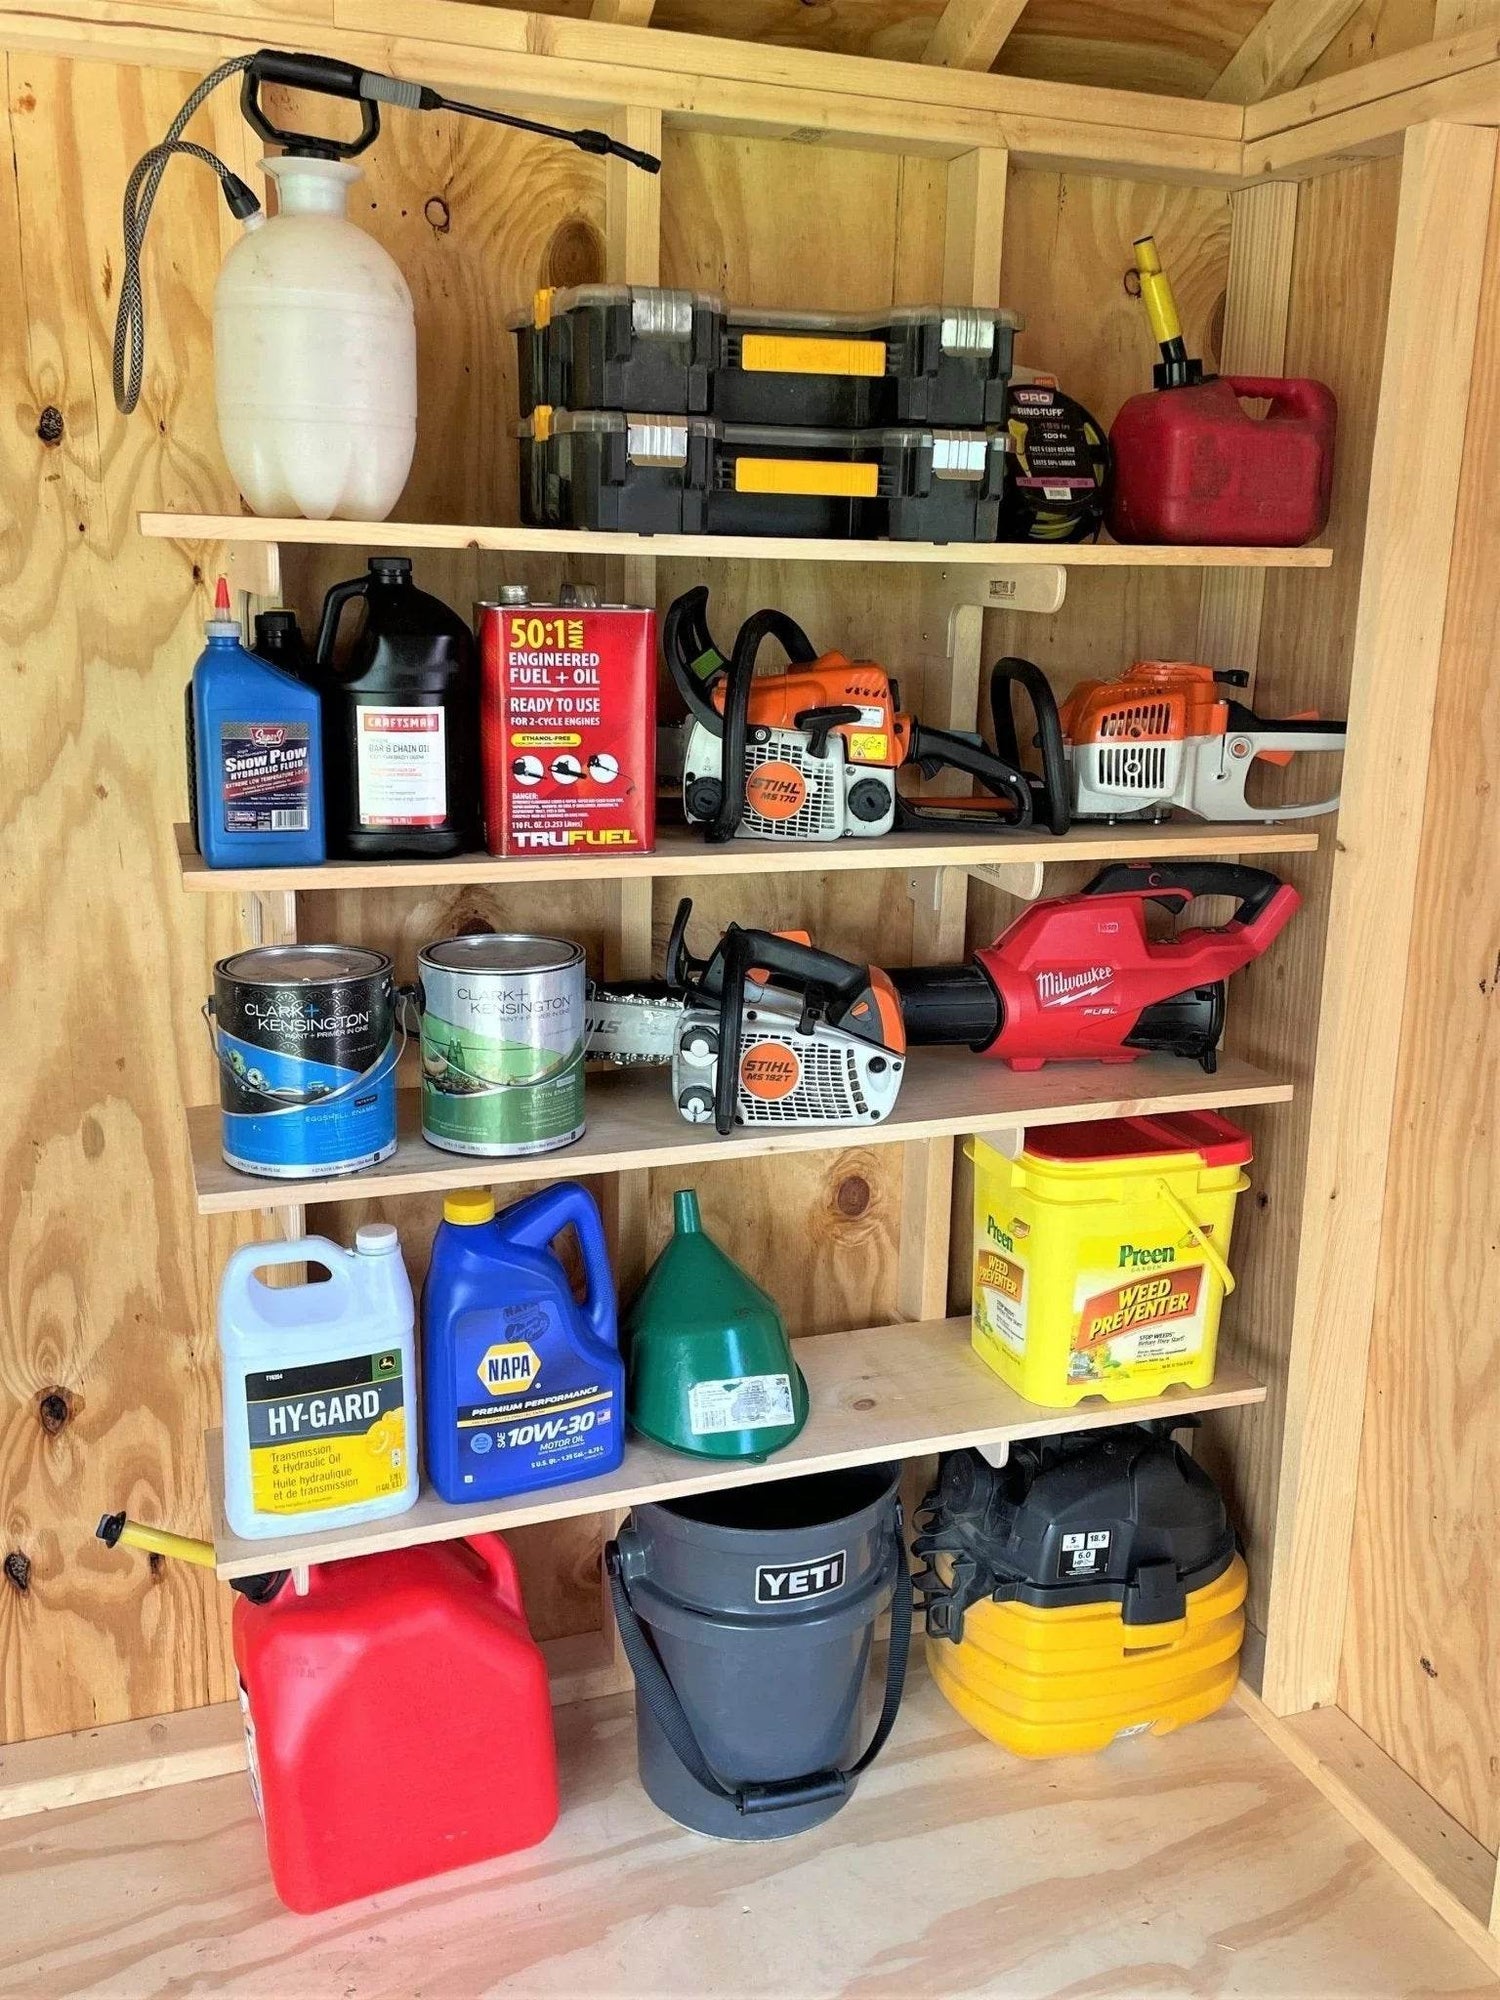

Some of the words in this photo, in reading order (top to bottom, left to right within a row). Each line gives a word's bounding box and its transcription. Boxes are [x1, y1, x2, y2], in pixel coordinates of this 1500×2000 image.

[1020, 393, 1050, 402] PRO
[510, 618, 565, 649] 50:1
[567, 620, 584, 649] MIX
[508, 652, 600, 666] ENGINEERED
[509, 667, 551, 684] FUEL
[555, 671, 569, 684] +
[573, 669, 600, 684] OIL
[510, 697, 554, 712] READY
[556, 698, 573, 712] TO
[576, 698, 600, 712] USE
[367, 717, 434, 729] CRAFTSMAN
[510, 717, 528, 725] FOR
[529, 717, 563, 726] 2-CYCLE
[564, 717, 600, 726] ENGINES
[393, 744, 417, 753] CHAIN
[230, 765, 279, 780] HYDRAULIC
[280, 760, 304, 771] FLUID
[750, 777, 801, 794] STIHL
[511, 829, 639, 848] TRUFUEL
[1036, 966, 1114, 1001] Milwaukee
[257, 1011, 369, 1032] KENSINGTON
[316, 1029, 346, 1038] PRIMER
[354, 1024, 369, 1033] ONE
[744, 1060, 793, 1073] STIHL
[746, 1073, 764, 1081] MS
[987, 1214, 1014, 1253] Preen
[988, 1255, 1009, 1277] WEED
[1118, 1244, 1175, 1268] Preen
[1118, 1279, 1171, 1311] WEED
[1089, 1292, 1190, 1342] PREVENTER
[488, 1355, 531, 1382] NAPA
[471, 1404, 523, 1417] PREMIUM
[524, 1385, 599, 1409] PERFORMANCE
[268, 1389, 380, 1436] HY-GARD
[507, 1410, 596, 1447] 10W-30
[271, 1445, 331, 1462] Transmission
[540, 1438, 571, 1451] MOTOR
[572, 1435, 585, 1444] OIL
[272, 1464, 280, 1474] &
[283, 1456, 326, 1474] Hydraulic
[328, 1453, 341, 1464] Oil
[273, 1477, 297, 1489] Huile
[299, 1467, 352, 1487] hydraulique
[273, 1491, 283, 1501] et
[286, 1488, 298, 1499] de
[301, 1478, 358, 1497] transmission
[1090, 1534, 1106, 1542] 18.9
[763, 1560, 839, 1596] YETI
